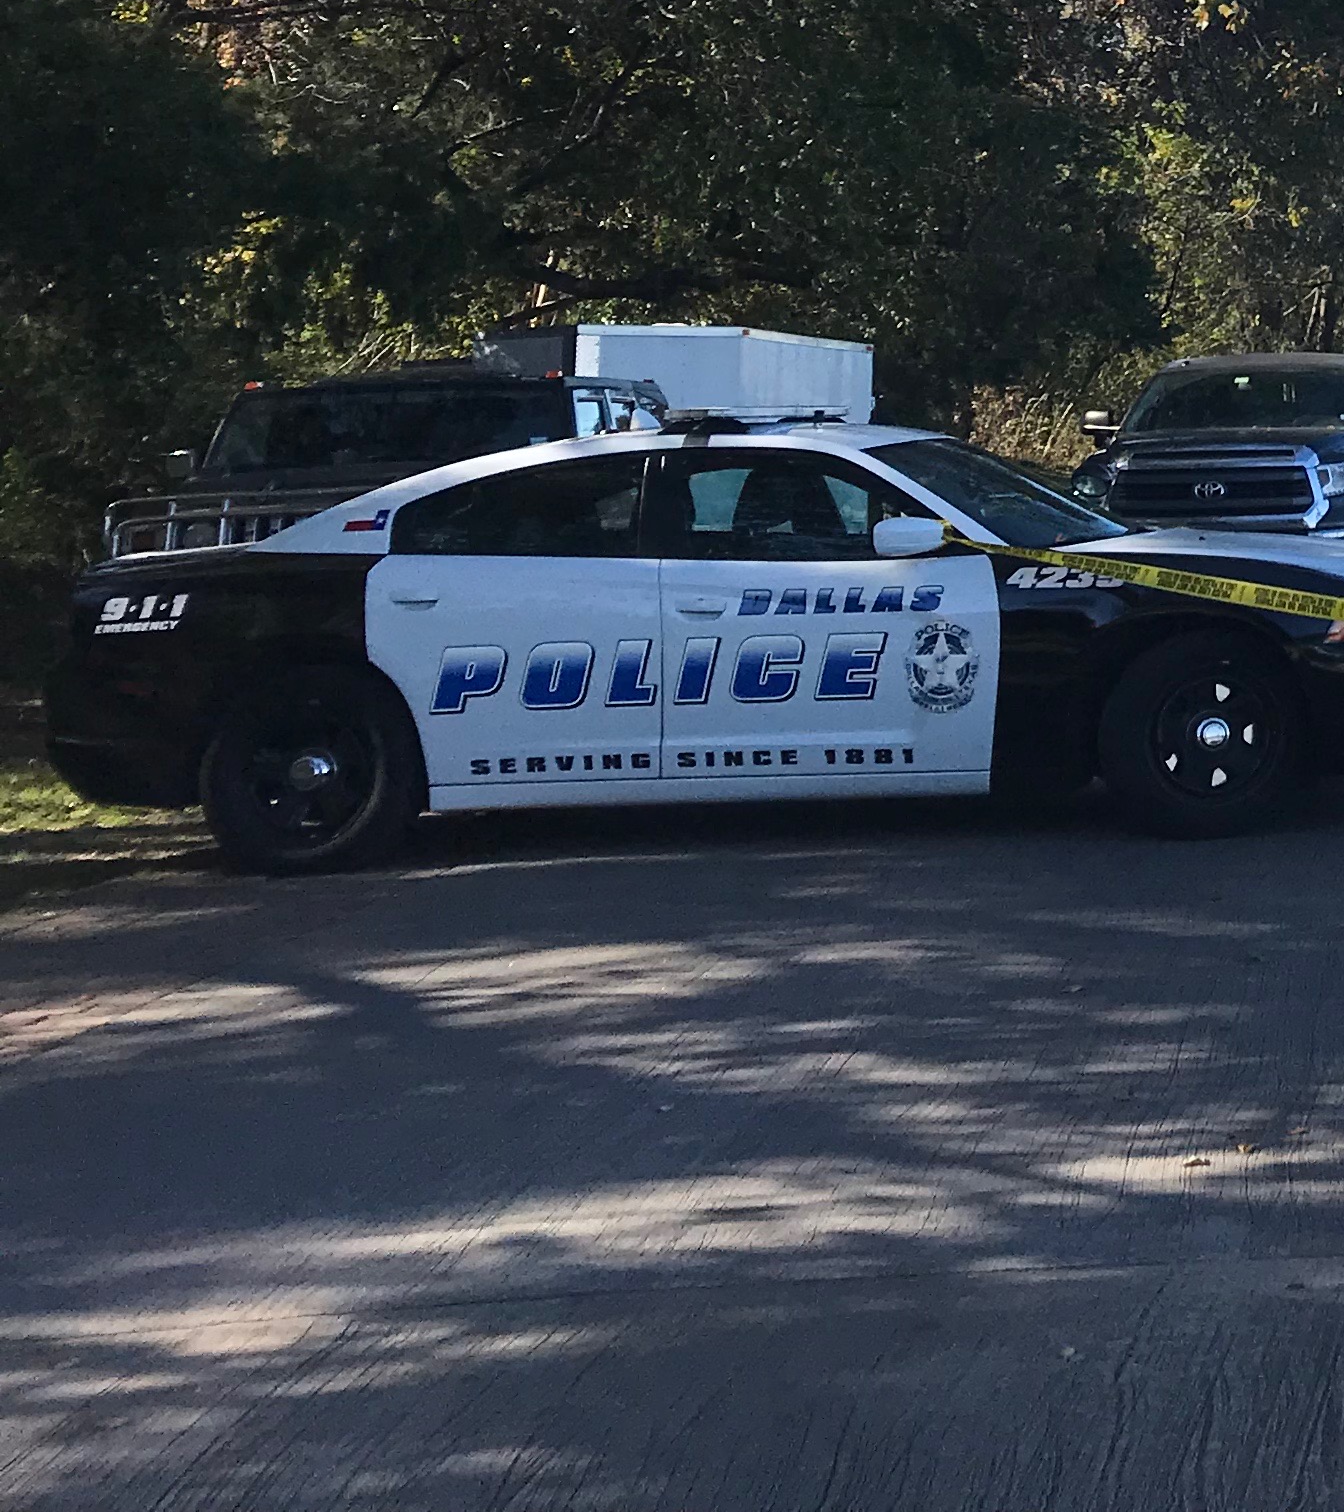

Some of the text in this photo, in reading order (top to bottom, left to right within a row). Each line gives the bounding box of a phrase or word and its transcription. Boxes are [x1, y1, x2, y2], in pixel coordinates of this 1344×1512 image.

[737, 584, 945, 616] DALLAS
[93, 620, 180, 635] EMERGENCY
[914, 622, 970, 640] POLICE
[429, 631, 889, 715] POLICE
[470, 747, 915, 776] SERVING SINCE 1881
